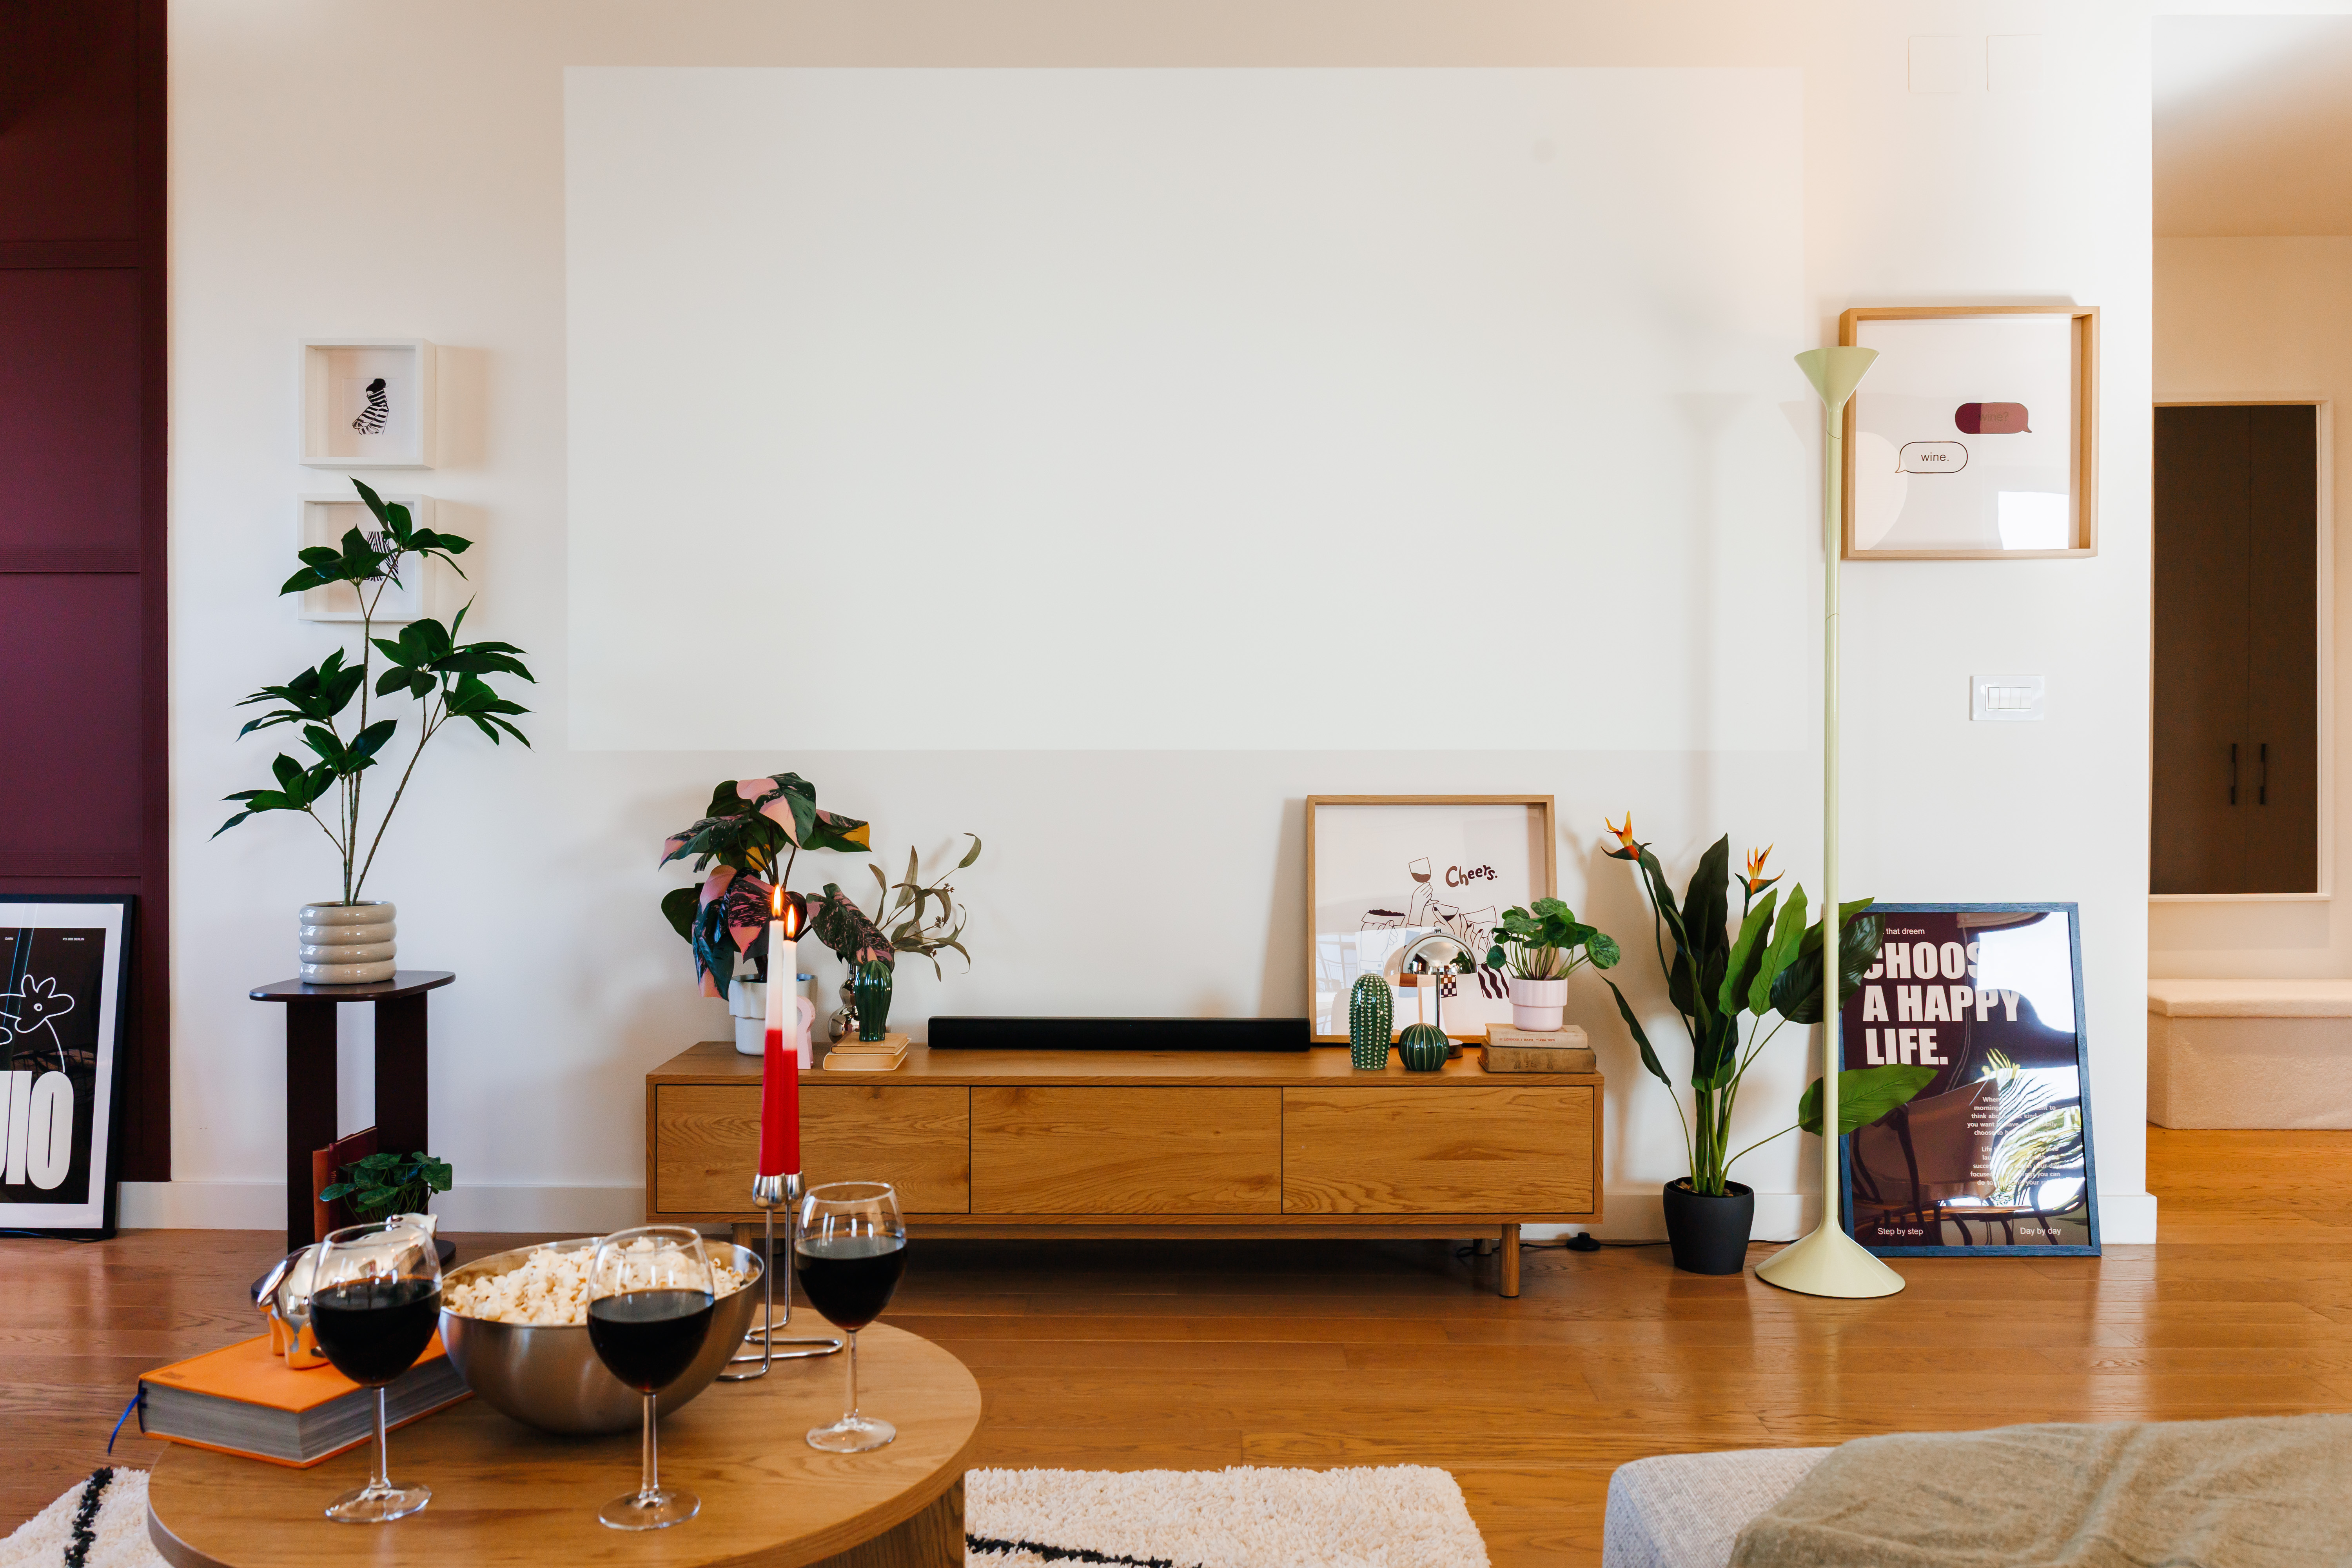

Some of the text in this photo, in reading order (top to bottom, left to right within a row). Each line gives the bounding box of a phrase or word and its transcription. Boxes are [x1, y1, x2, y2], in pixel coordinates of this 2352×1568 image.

[1921, 452, 1949, 462] wine.
[1445, 865, 1498, 887] Cheers.
[1863, 985, 2020, 1022] A HAPPY
[1865, 1028, 1948, 1065] LIFE.
[2020, 1227, 2061, 1236] Day by day
